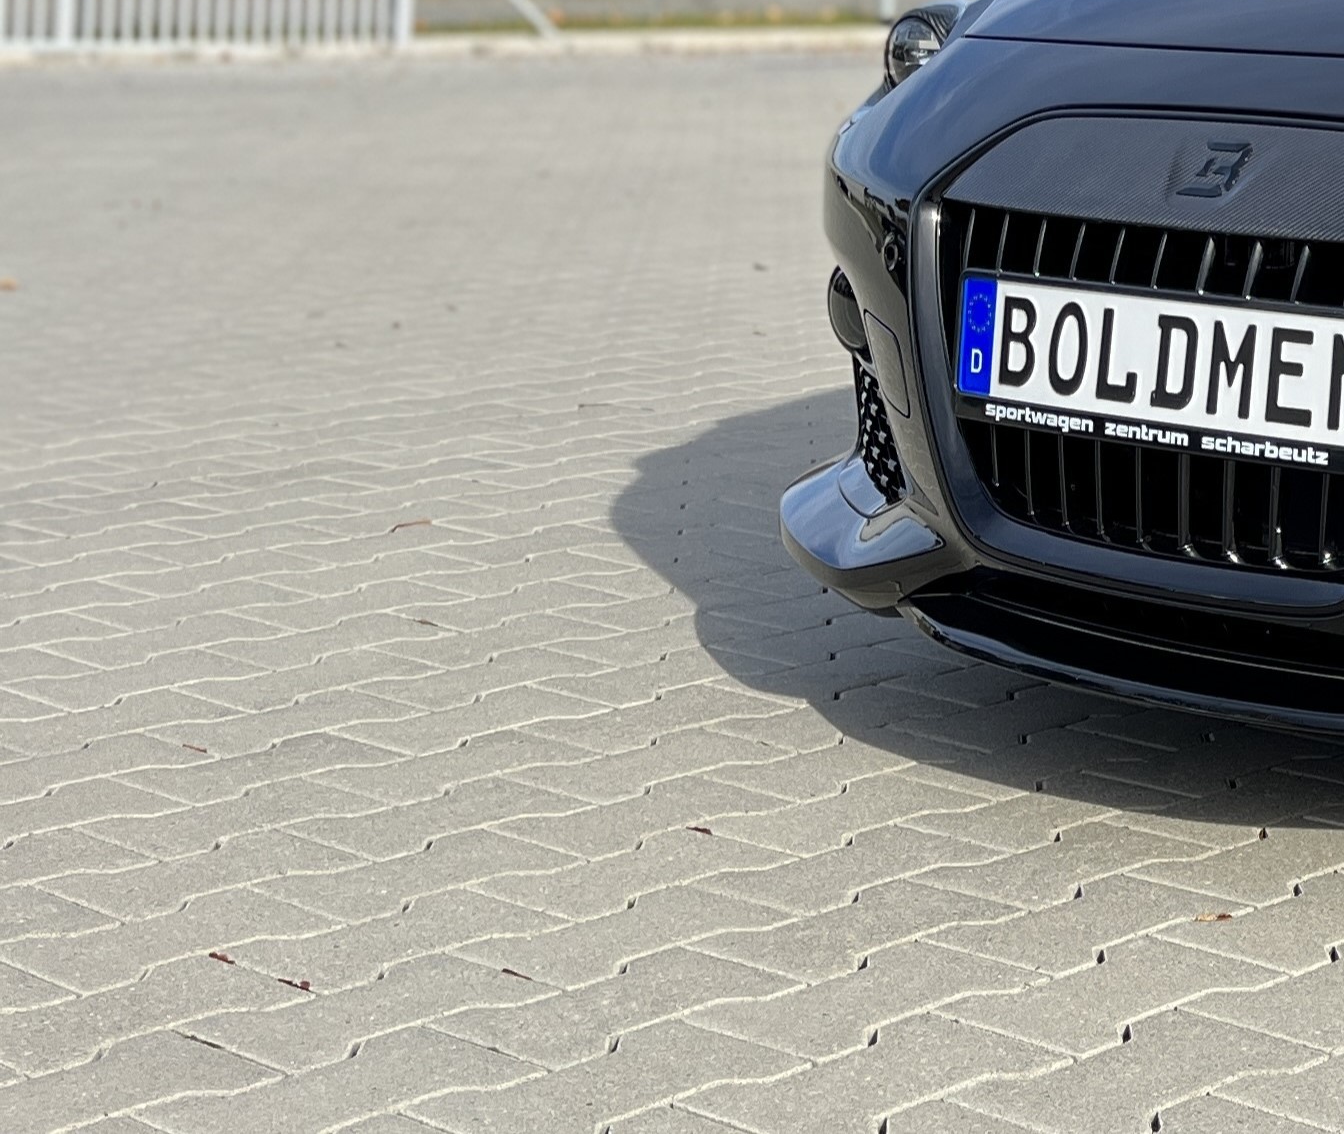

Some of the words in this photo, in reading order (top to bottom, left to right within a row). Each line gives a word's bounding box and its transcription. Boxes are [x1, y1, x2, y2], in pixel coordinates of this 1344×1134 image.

[970, 348, 983, 374] D
[985, 402, 1094, 434] sportwagen
[1104, 421, 1189, 447] zentrum
[1200, 434, 1330, 466] scharbeutz
